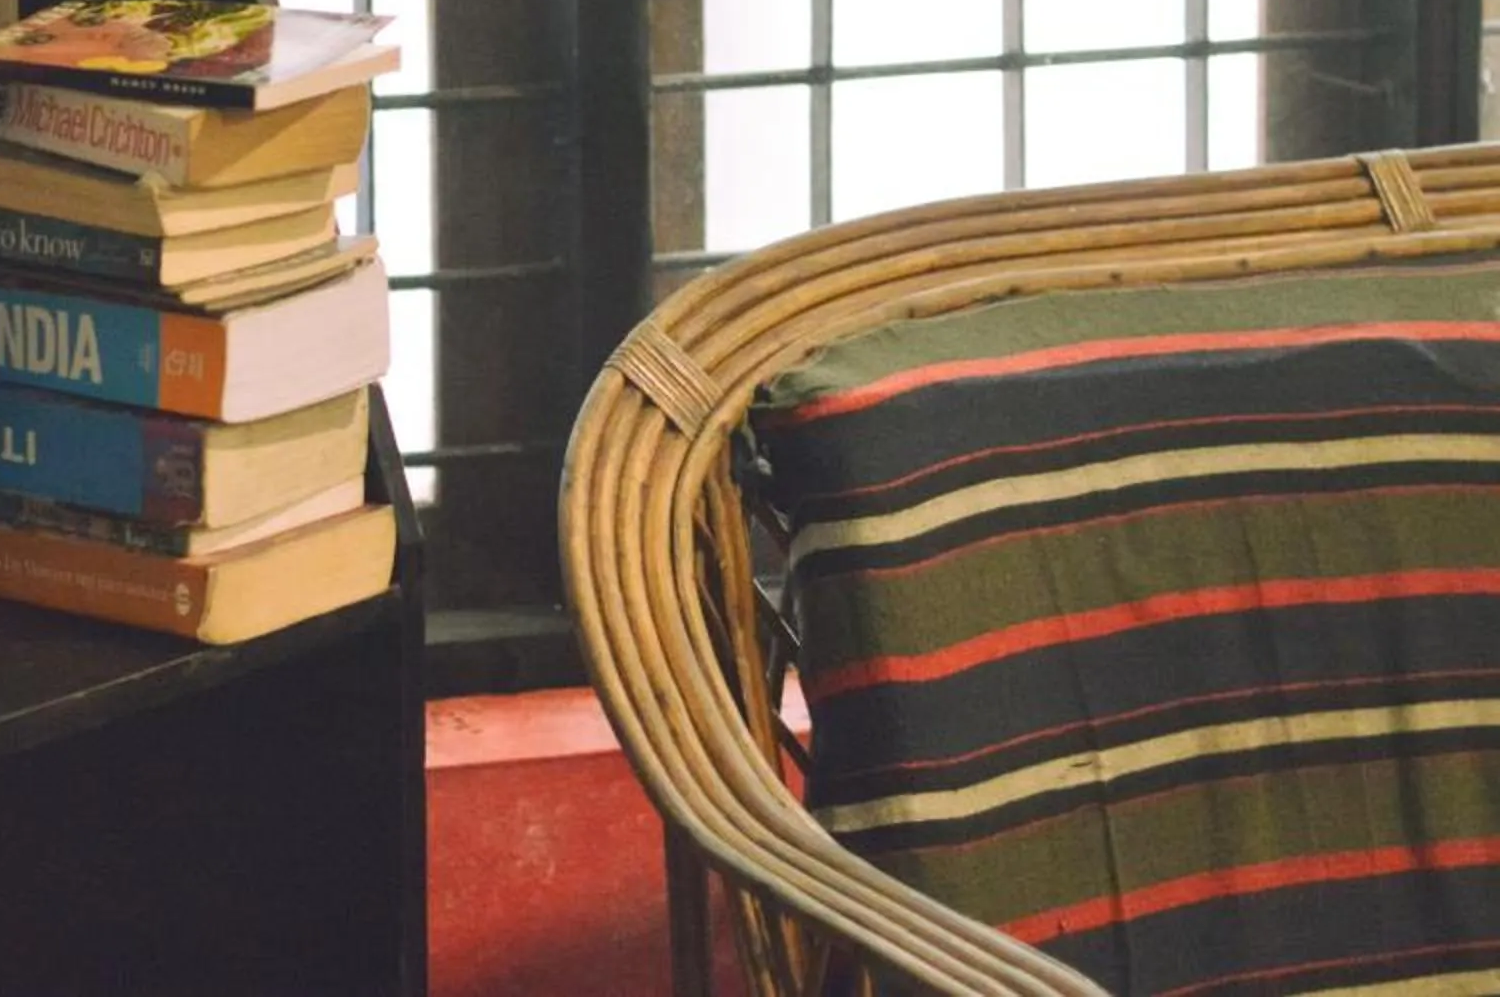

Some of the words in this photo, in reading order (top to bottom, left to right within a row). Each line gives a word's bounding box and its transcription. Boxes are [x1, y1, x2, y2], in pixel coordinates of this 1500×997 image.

[9, 85, 89, 144] Michael
[90, 104, 171, 167] Crichton
[20, 218, 88, 260] know
